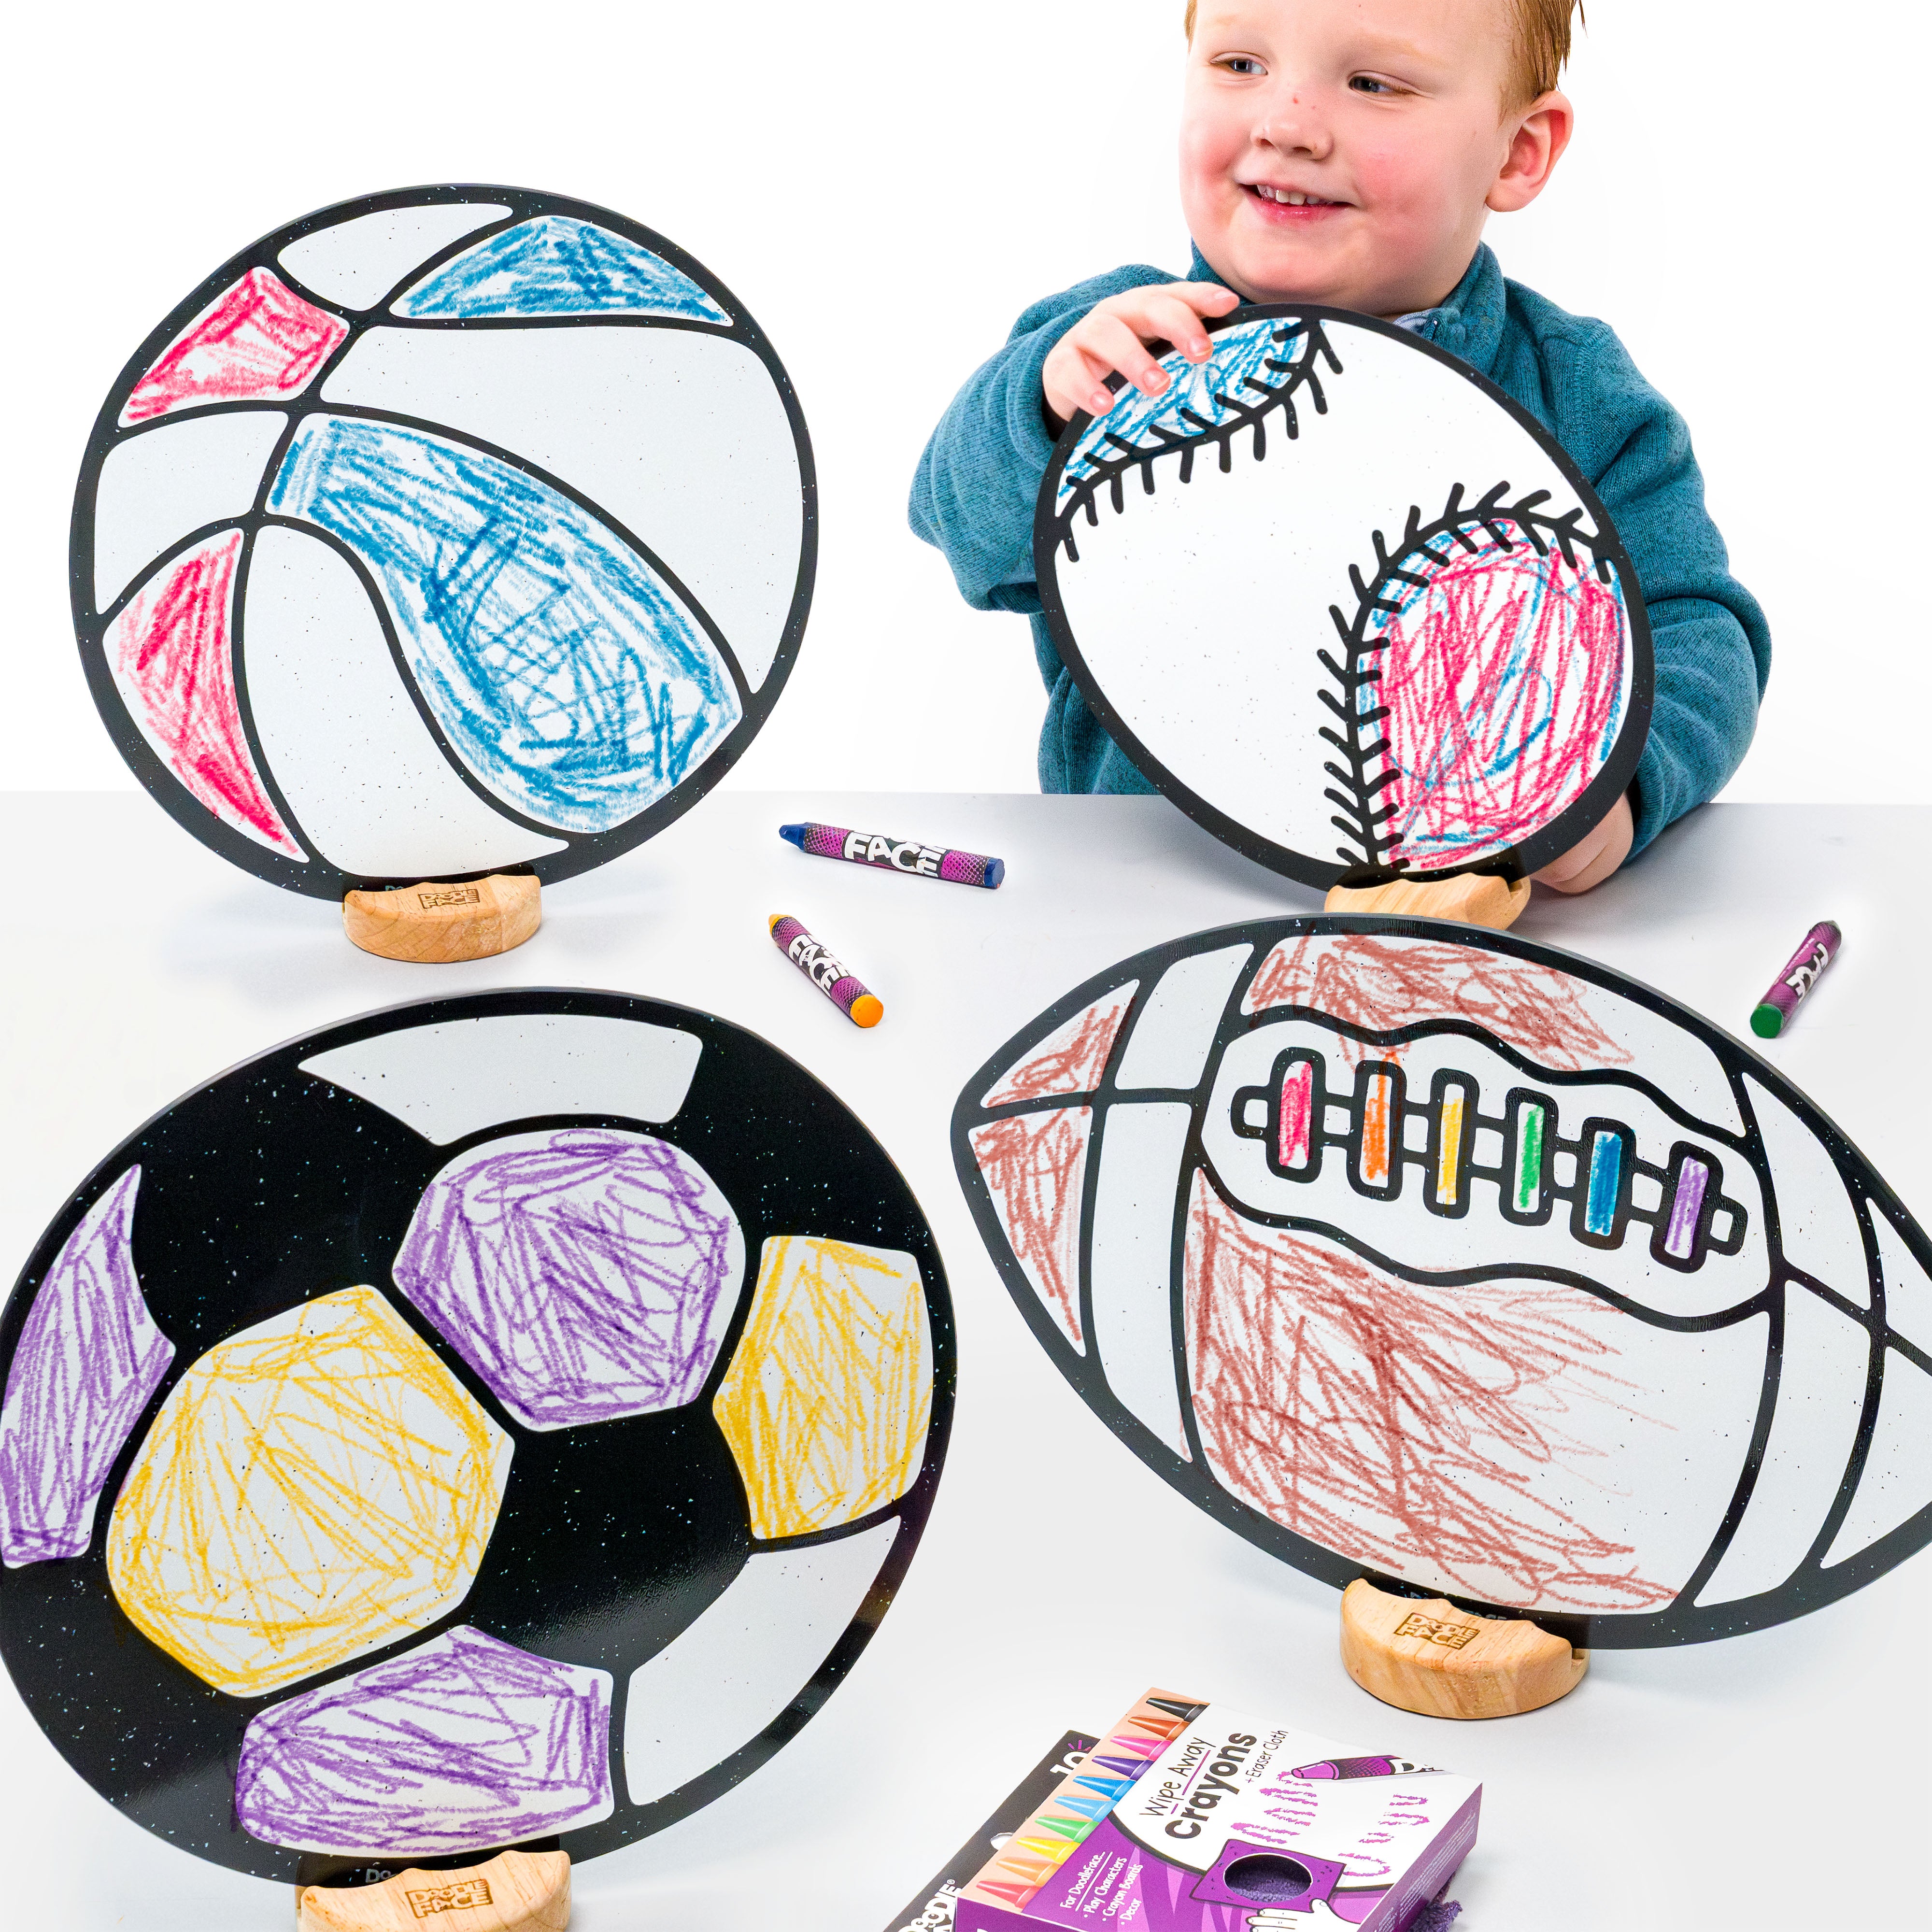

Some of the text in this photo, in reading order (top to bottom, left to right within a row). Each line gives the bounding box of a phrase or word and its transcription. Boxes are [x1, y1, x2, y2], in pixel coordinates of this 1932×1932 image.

[844, 832, 942, 878] FACE
[423, 895, 480, 909] FACE
[788, 934, 841, 998] FACE
[1396, 1624, 1471, 1649] FACE
[1407, 1614, 1478, 1638] DOODLE
[1246, 1751, 1273, 1777] Eraser
[1263, 1730, 1289, 1750] Cloth
[1139, 1737, 1216, 1816] Wipe Away
[1165, 1733, 1257, 1839] Crayons
[409, 1879, 488, 1904] DOODLE
[1060, 1895, 1077, 1908] For
[1083, 1857, 1127, 1913] Play Characters
[1102, 1863, 1144, 1916] Crayon Boards
[412, 1893, 492, 1918] FACE
[1119, 1898, 1142, 1921] Decor
